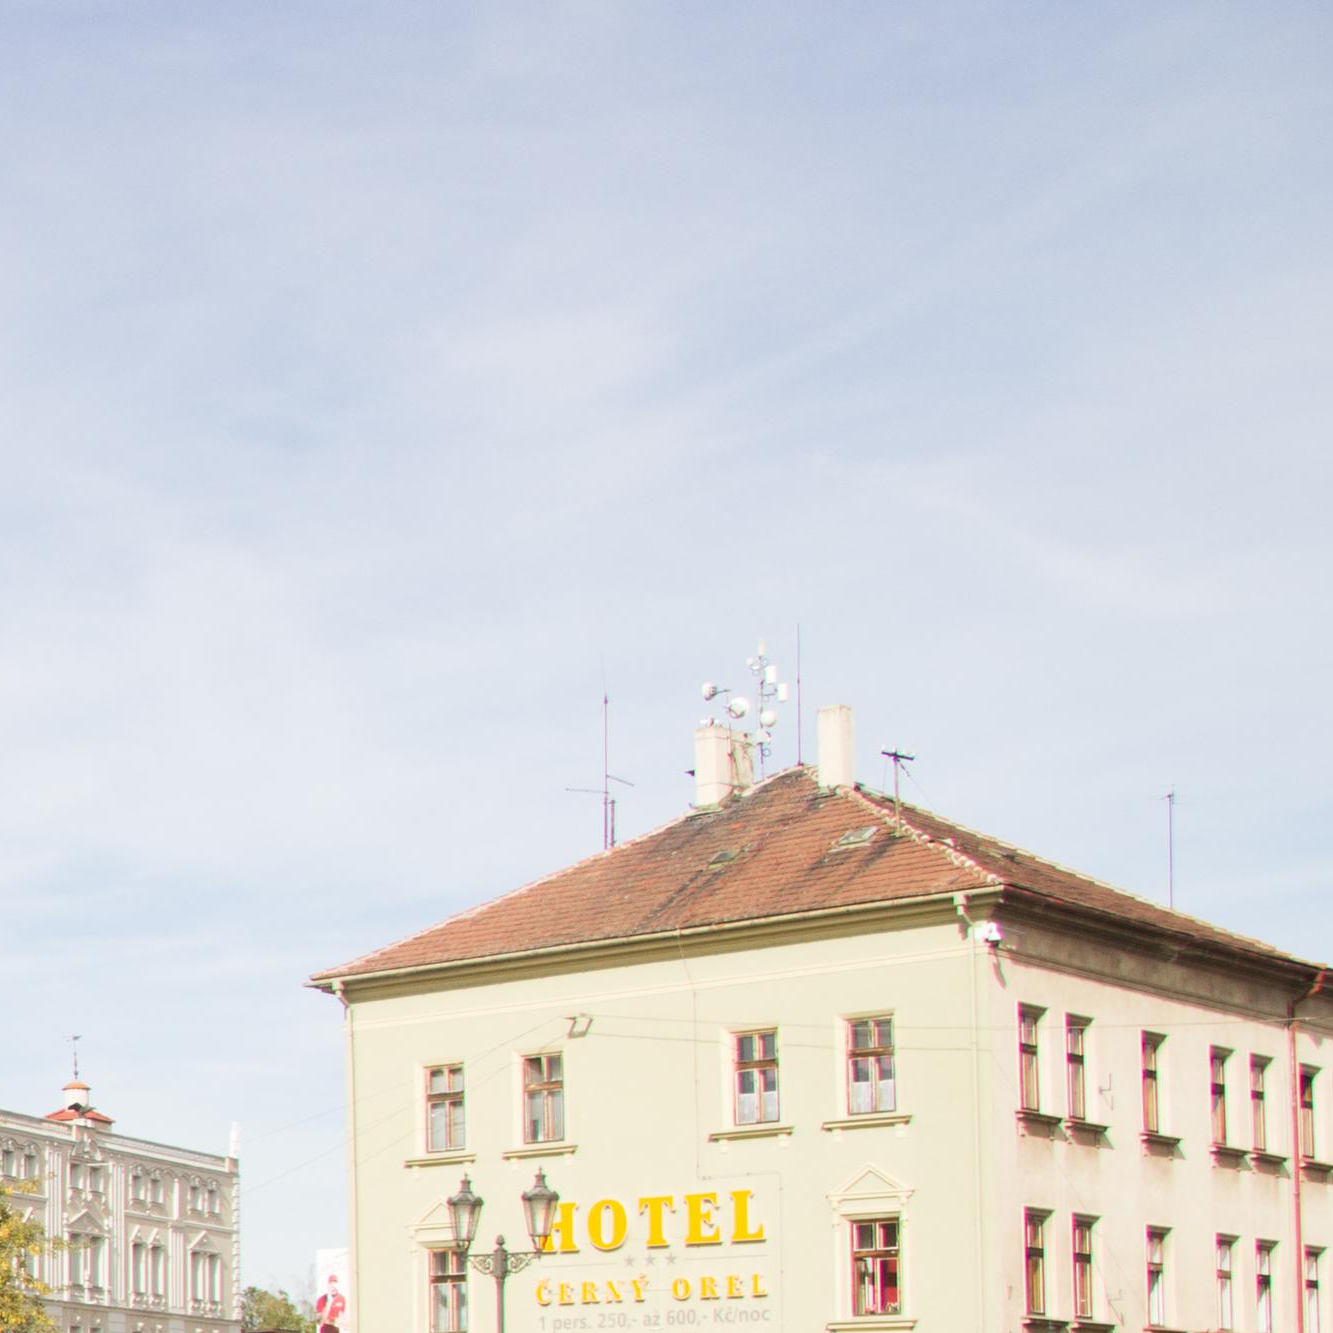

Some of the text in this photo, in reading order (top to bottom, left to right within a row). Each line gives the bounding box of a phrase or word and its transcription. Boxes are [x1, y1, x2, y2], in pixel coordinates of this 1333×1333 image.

[539, 1190, 766, 1253] HOTEL
[536, 1272, 768, 1306] ČERNÝ OREL
[539, 1317, 546, 1330] 1
[553, 1316, 592, 1333] pers.
[597, 1312, 637, 1330] 250,-
[713, 1308, 770, 1325] Kč/noc
